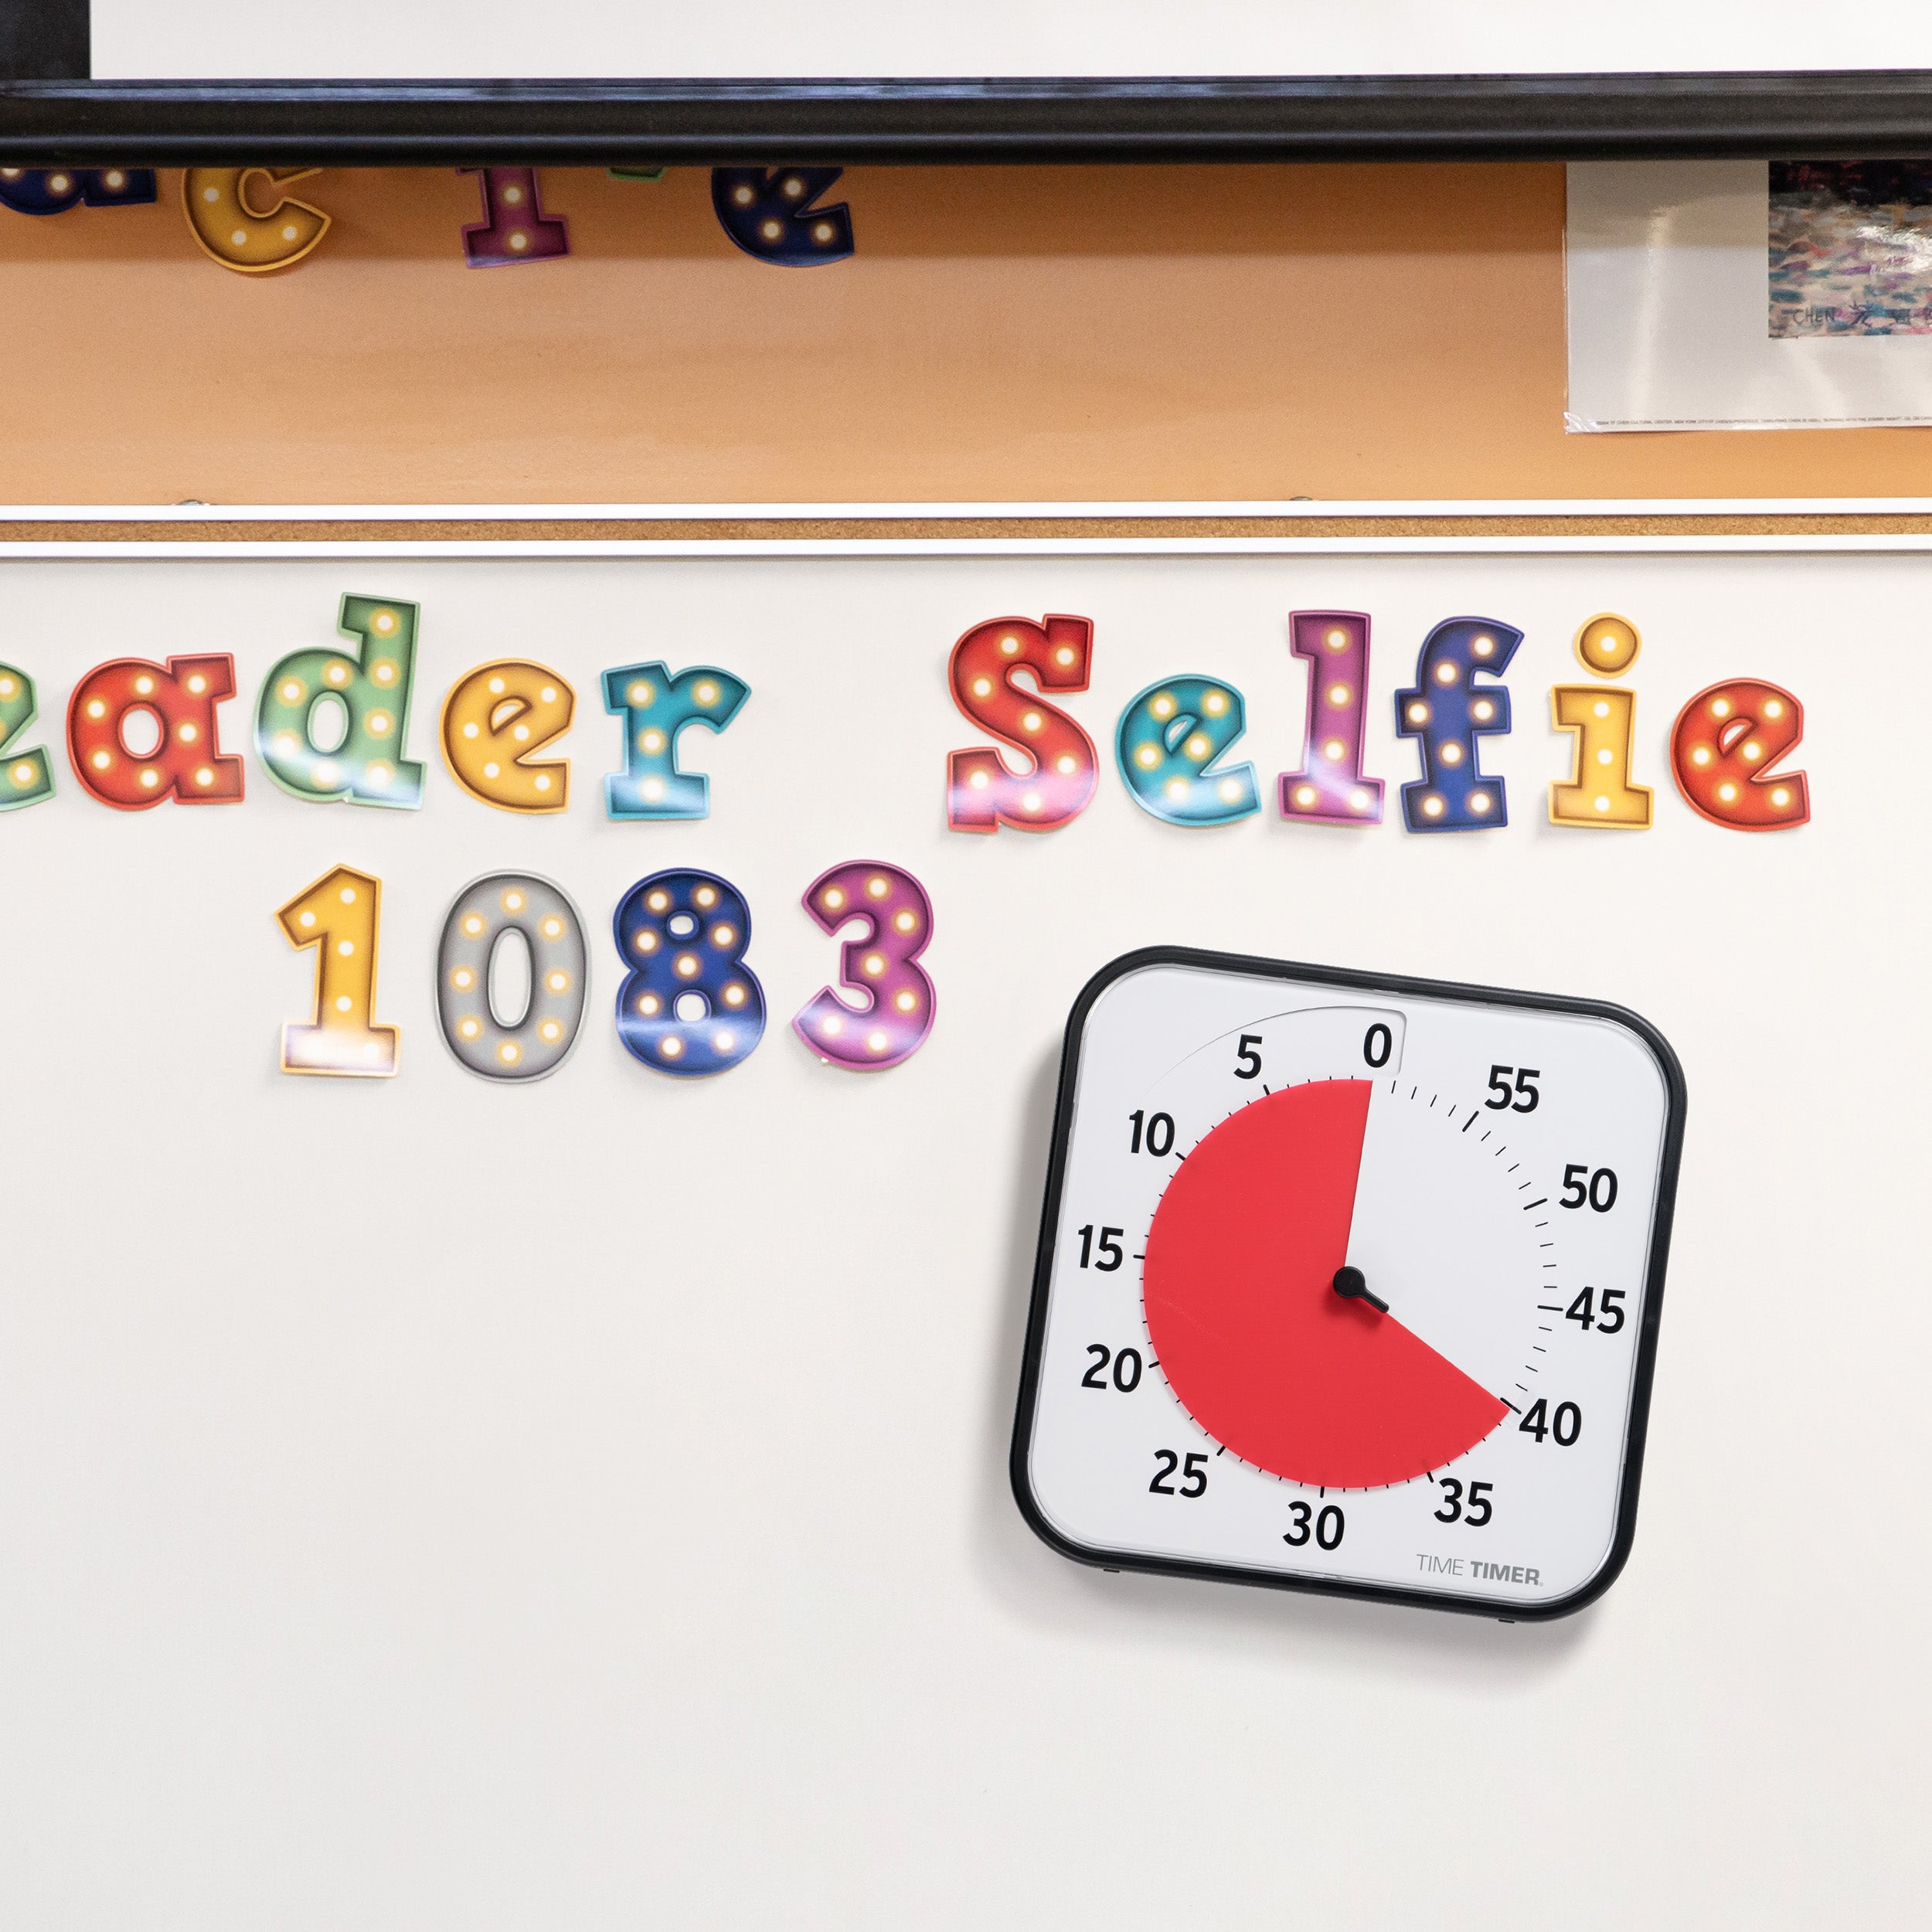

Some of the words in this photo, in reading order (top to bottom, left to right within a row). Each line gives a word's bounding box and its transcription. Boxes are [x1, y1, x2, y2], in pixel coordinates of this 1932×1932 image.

[947, 611, 1812, 833] Selfie
[274, 859, 938, 1083] 1083
[1234, 1035, 1262, 1079] 5
[1364, 1023, 1392, 1067] 0
[1485, 1065, 1539, 1113] 55
[1130, 1110, 1175, 1157] 10
[1560, 1165, 1617, 1213] 50
[1079, 1225, 1123, 1271] 15
[1566, 1287, 1625, 1333] 45
[1082, 1344, 1141, 1393] 20
[1519, 1399, 1581, 1446] 40
[1149, 1450, 1208, 1498] 25
[1283, 1502, 1344, 1550] 30
[1434, 1479, 1492, 1526] 35
[1417, 1554, 1464, 1576] TIME
